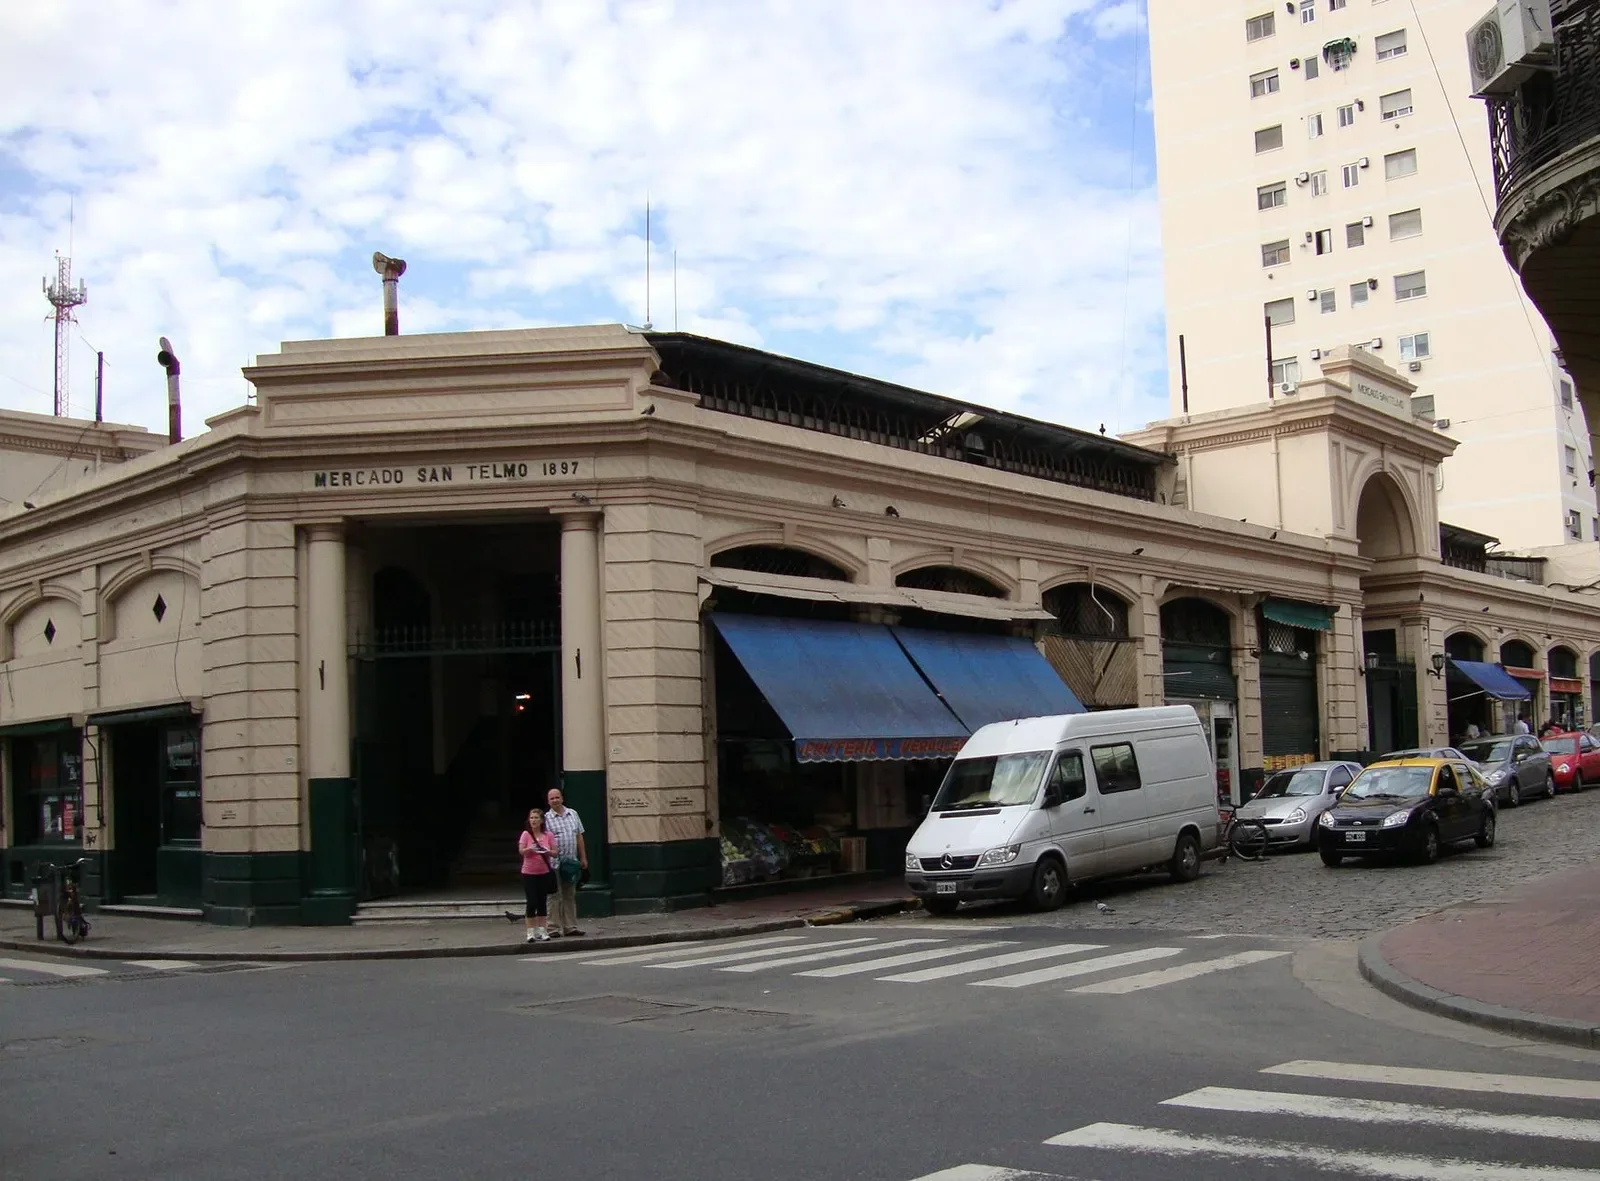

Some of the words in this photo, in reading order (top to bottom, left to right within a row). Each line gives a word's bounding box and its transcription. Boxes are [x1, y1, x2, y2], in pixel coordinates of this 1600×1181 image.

[314, 468, 404, 488] MERCADO
[416, 466, 453, 483] SAN
[466, 462, 529, 480] TELMO
[542, 460, 580, 476] 1897
